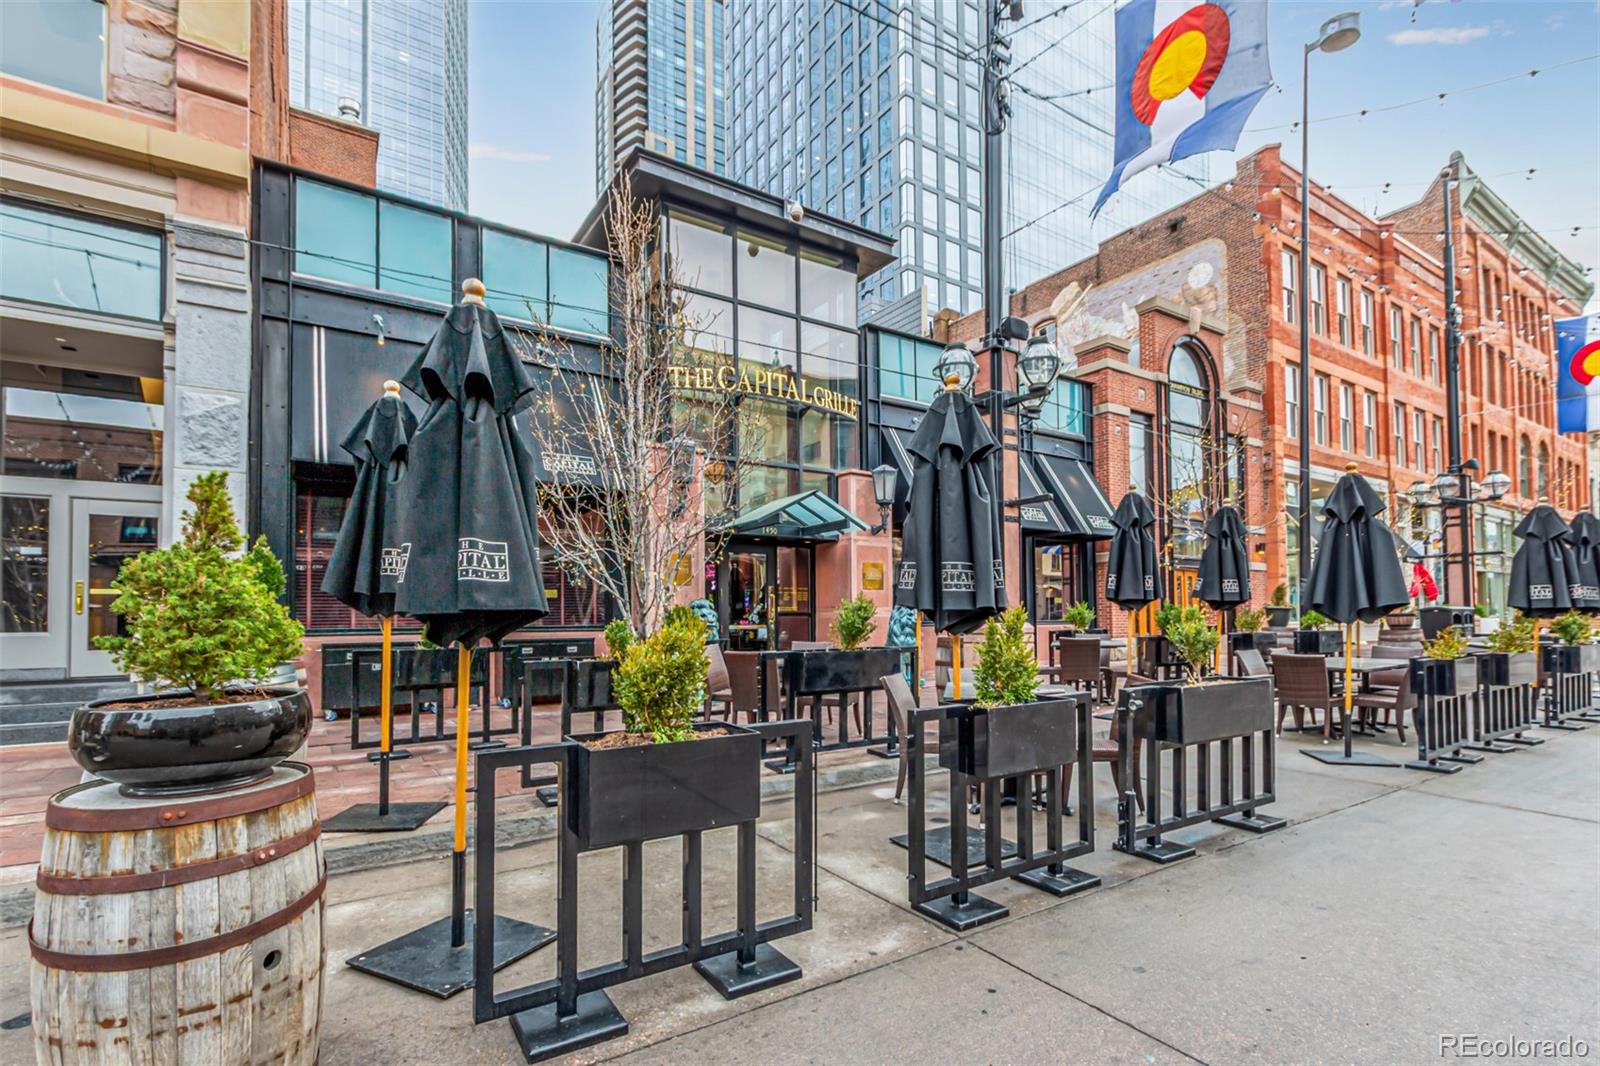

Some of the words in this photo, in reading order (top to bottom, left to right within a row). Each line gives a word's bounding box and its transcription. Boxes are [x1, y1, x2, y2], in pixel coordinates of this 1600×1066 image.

[667, 366, 714, 389] THE
[717, 366, 813, 403] CAPITAL
[813, 386, 858, 418] GRILLE
[461, 540, 484, 551] HE
[458, 552, 506, 570] PITAL
